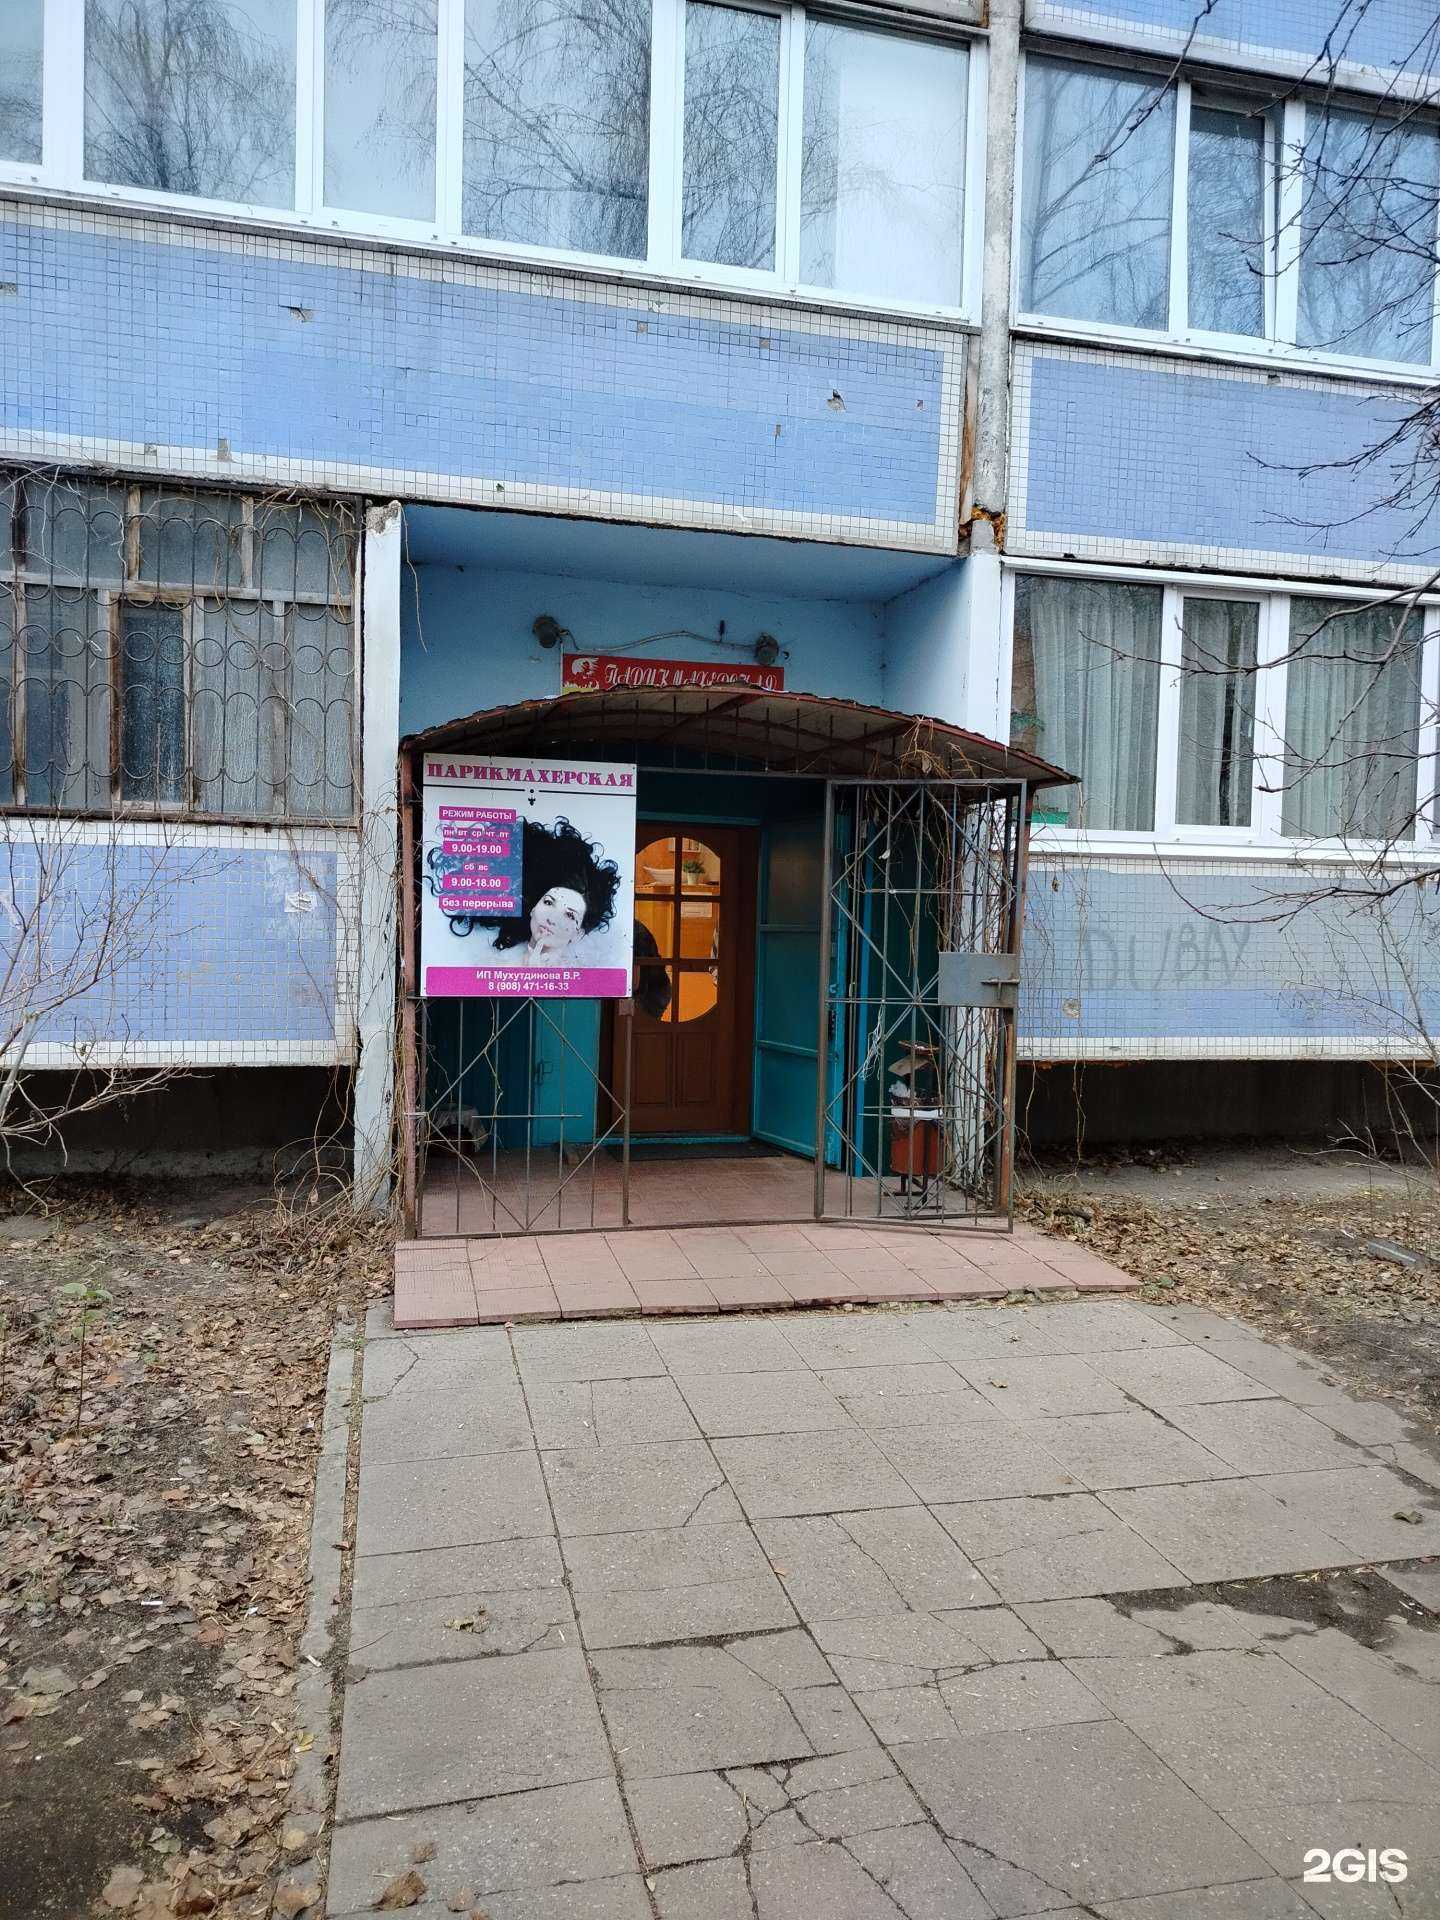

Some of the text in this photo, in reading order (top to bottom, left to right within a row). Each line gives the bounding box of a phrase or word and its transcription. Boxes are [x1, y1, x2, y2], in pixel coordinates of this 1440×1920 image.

[427, 763, 633, 787] ПАРИКМАХЕРСКАЯ
[442, 809, 512, 820] РЕЖИМ РАБОТЫ
[451, 843, 502, 854] 9.00-19.00
[451, 877, 501, 887] 9.00-18.00
[442, 898, 514, 909] без перерыва
[476, 971, 581, 981] ИП Мухутдинова В.Р.
[488, 982, 569, 992] 8 (908) 471-16-33
